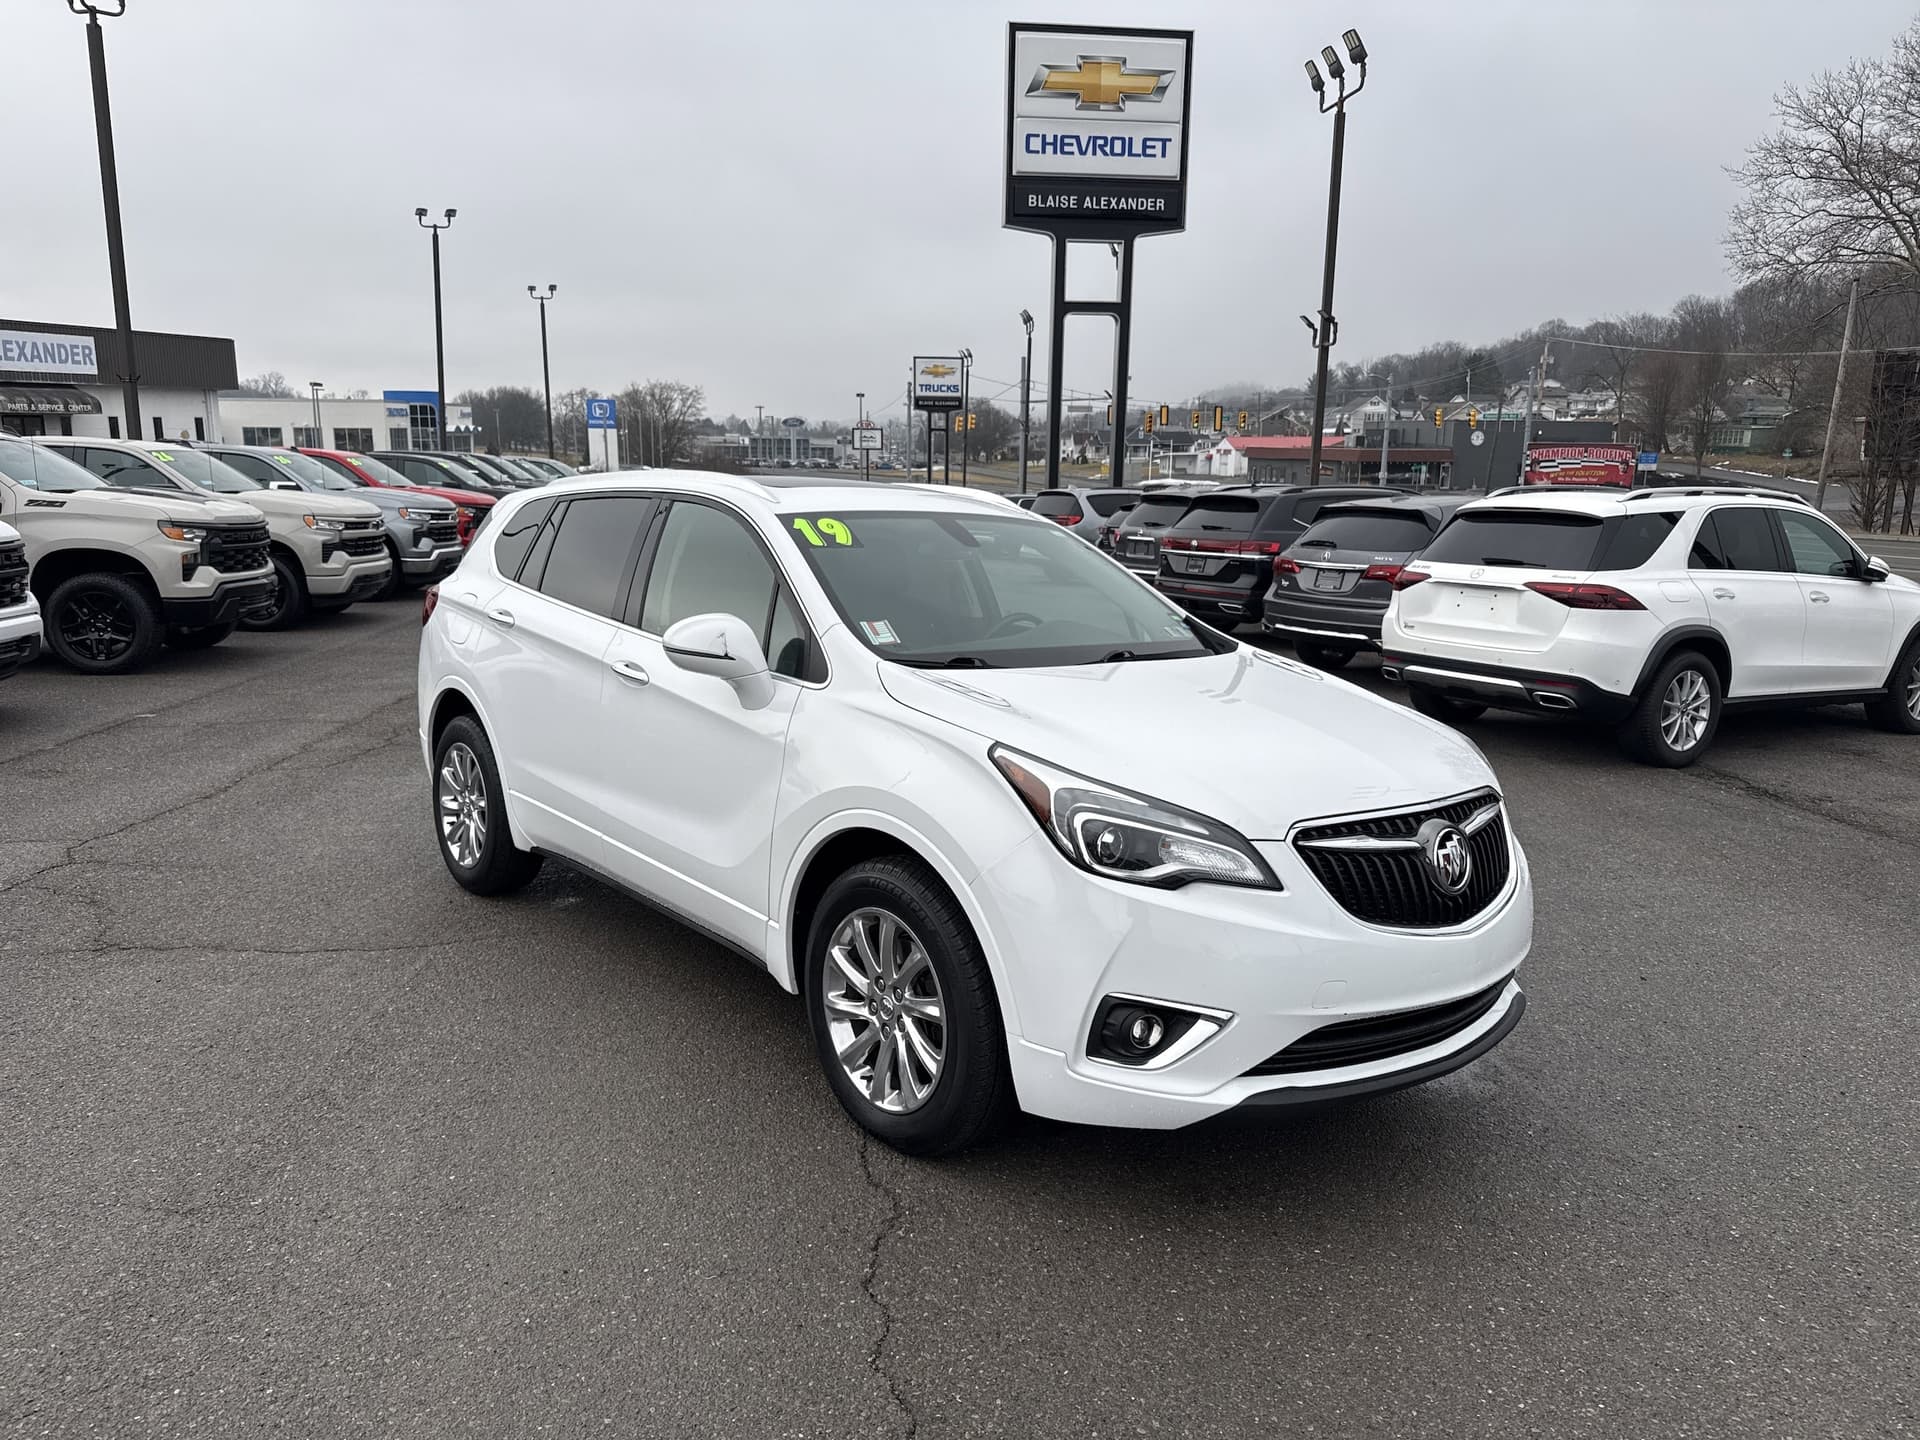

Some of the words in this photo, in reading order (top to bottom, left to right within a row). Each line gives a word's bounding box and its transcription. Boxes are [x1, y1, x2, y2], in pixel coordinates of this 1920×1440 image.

[1025, 133, 1172, 158] CHEVROLET
[1028, 194, 1078, 209] BLAISE
[1083, 196, 1165, 211] ALEXANDER
[0, 339, 95, 366] EXANDER
[918, 383, 960, 393] TRUCKS
[7, 403, 29, 411] PARTS
[38, 404, 65, 412] SERVICE
[1530, 447, 1585, 461] CHAMPION
[1587, 447, 1633, 463] ROOFING
[793, 517, 852, 547] 19
